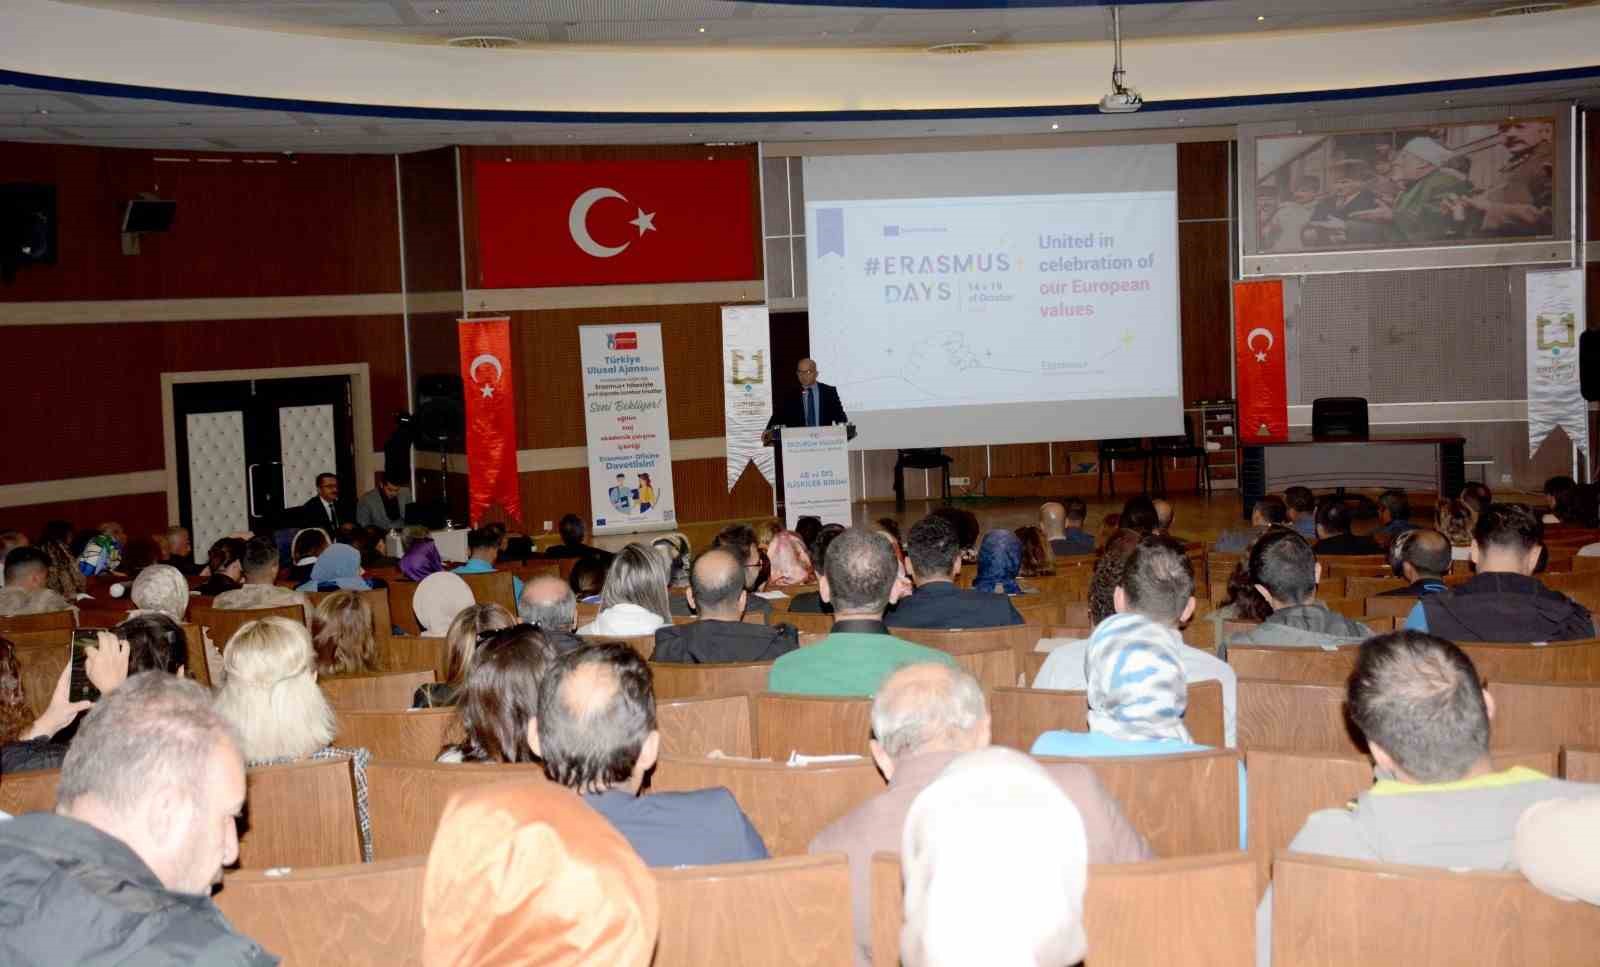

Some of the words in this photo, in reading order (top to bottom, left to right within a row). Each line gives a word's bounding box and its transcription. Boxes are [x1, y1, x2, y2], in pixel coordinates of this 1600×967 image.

[1040, 232, 1093, 249] United
[1099, 232, 1114, 248] in
[864, 253, 1010, 275] #ERASMUS
[1040, 255, 1133, 272] celebration
[1137, 251, 1154, 269] of
[884, 281, 952, 303] DAYS
[1040, 281, 1068, 295] our
[1071, 279, 1151, 296] European
[1040, 302, 1095, 318] values
[605, 355, 640, 365] Türkiye
[587, 366, 616, 375] Ulusal
